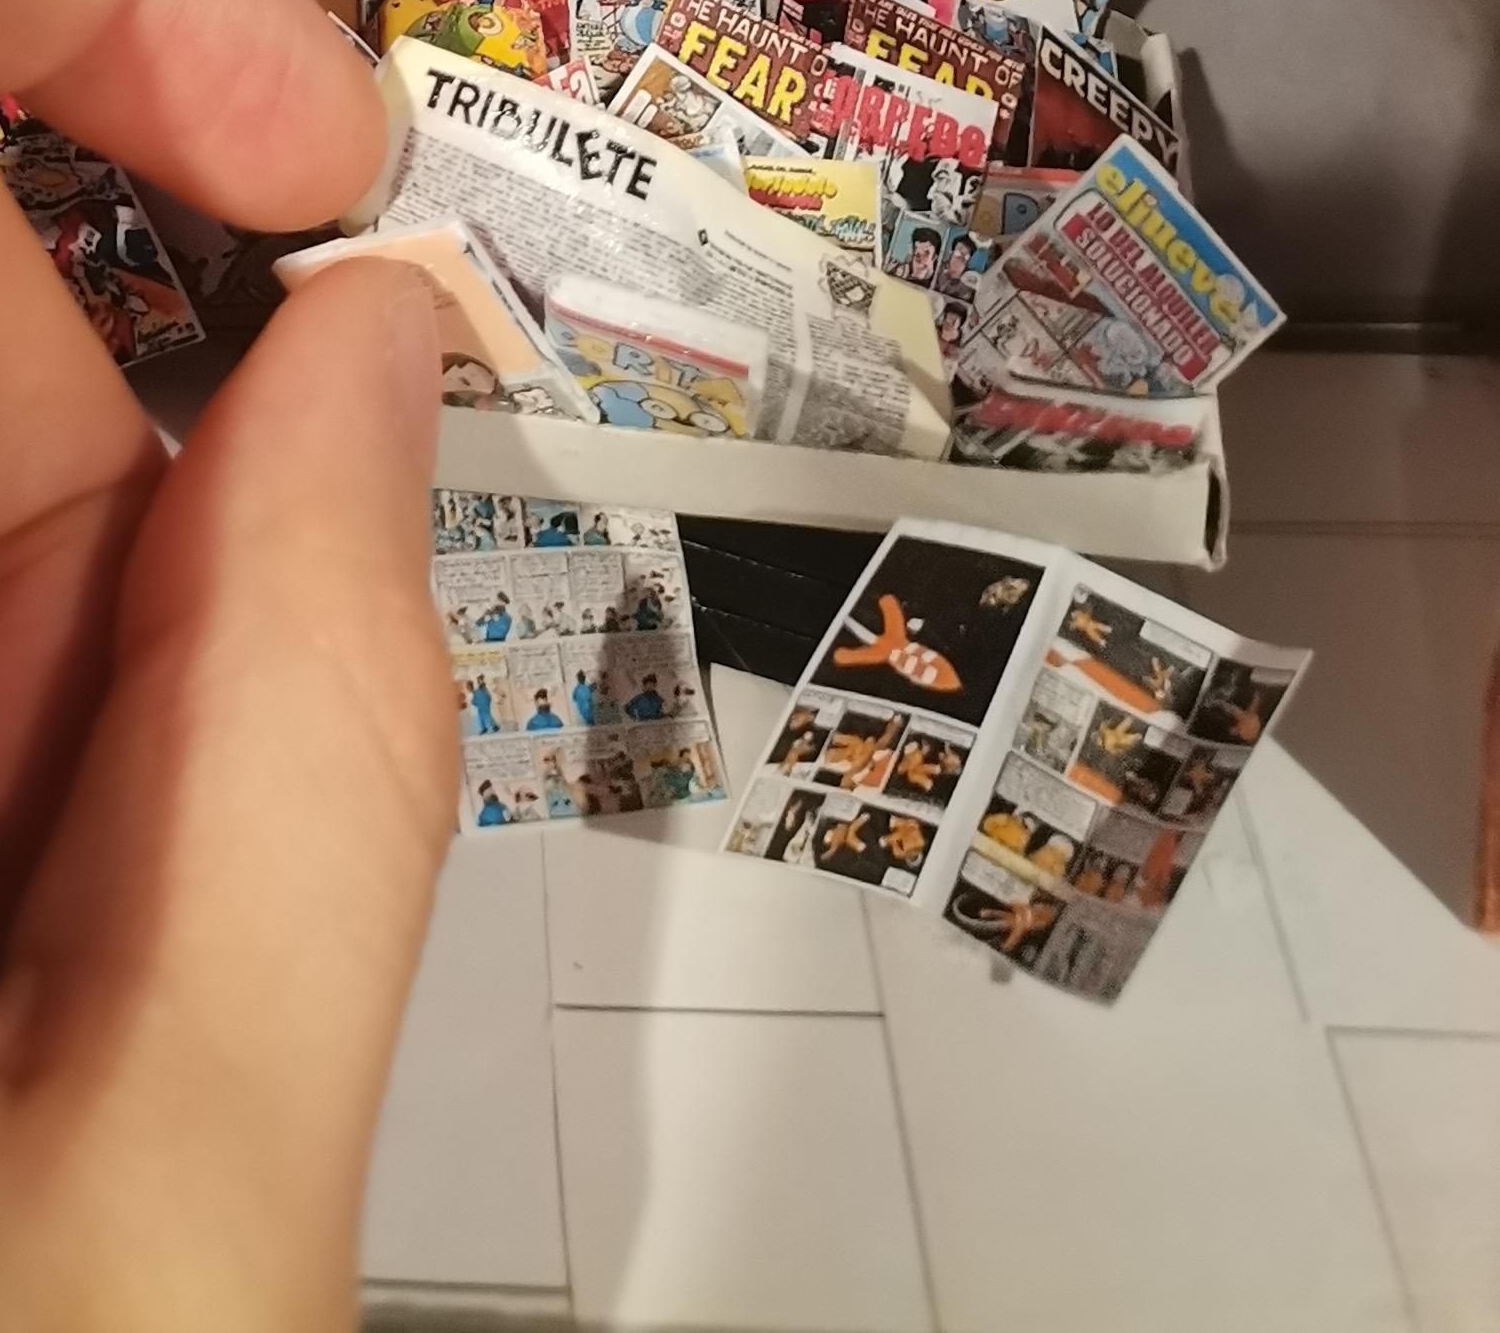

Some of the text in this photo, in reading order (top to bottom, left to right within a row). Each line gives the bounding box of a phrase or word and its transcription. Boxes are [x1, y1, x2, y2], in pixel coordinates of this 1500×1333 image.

[678, 20, 808, 125] FEAR
[716, 8, 808, 65] HAUNT
[810, 55, 829, 77] O
[895, 17, 989, 73] HAUNT
[994, 64, 1024, 89] OF
[426, 67, 657, 201] TRIBULETE
[1039, 37, 1179, 166] CREEPY
[1086, 201, 1115, 238] LO
[1108, 228, 1145, 268] DEL
[1074, 227, 1195, 364] SOLUCIONADO
